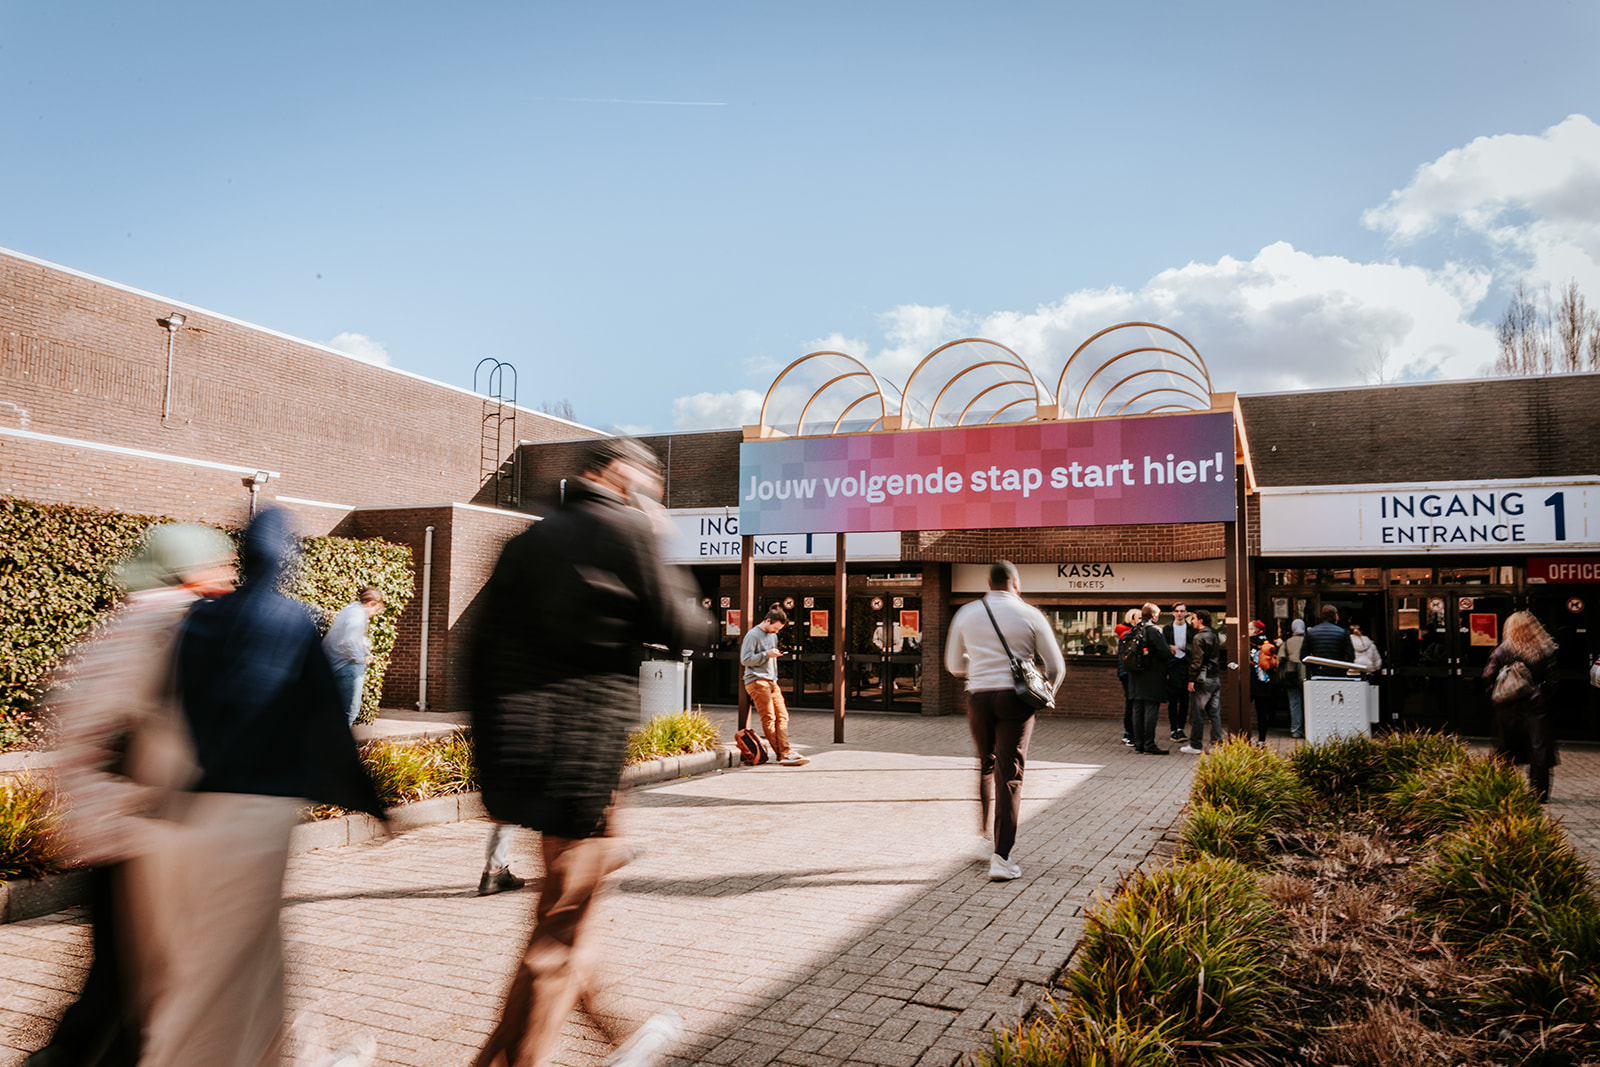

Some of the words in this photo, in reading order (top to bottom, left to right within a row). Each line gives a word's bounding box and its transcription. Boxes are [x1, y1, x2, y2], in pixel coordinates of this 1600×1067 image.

[745, 475, 817, 501] Jouw
[823, 466, 963, 503] volgende
[970, 466, 1043, 498] stap
[1050, 459, 1135, 489] start
[1143, 452, 1225, 485] hier!
[1381, 492, 1524, 518] INGANG
[1544, 491, 1566, 541] 1
[700, 517, 738, 536] ING
[1382, 524, 1526, 543] ENTRANCE
[699, 540, 788, 556] ENTRNCE
[1057, 564, 1115, 578] KASSA
[1548, 563, 1600, 580] OFFICE
[1068, 580, 1105, 589] TICKETS
